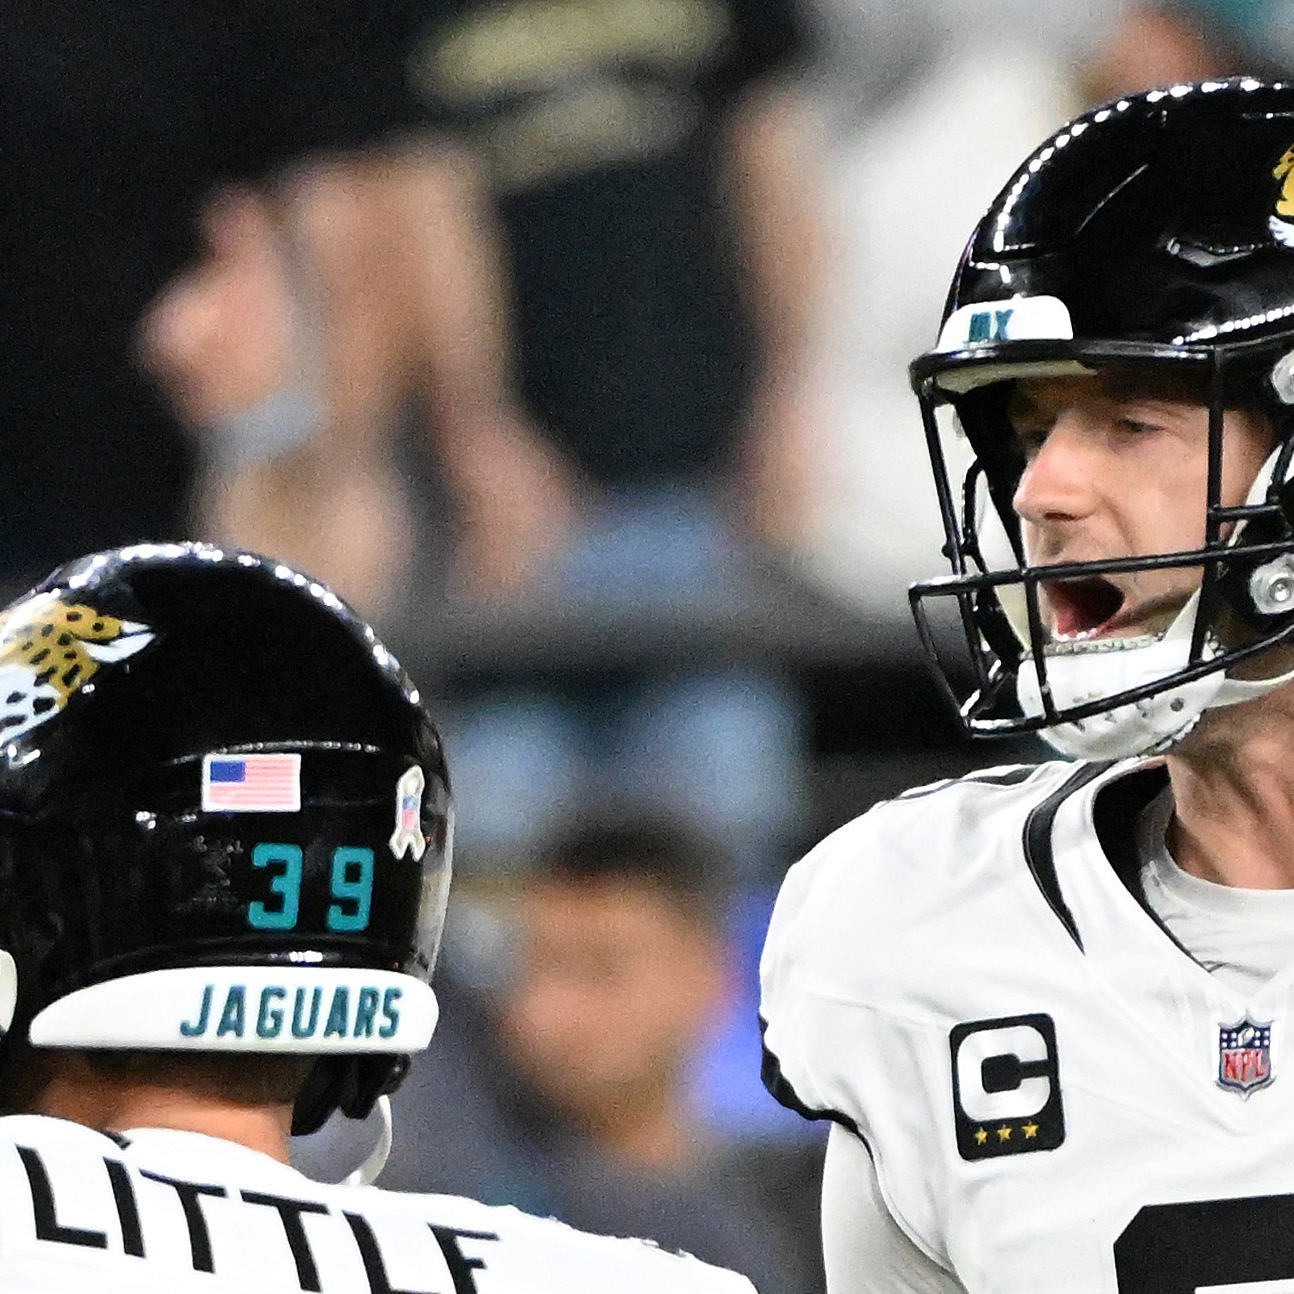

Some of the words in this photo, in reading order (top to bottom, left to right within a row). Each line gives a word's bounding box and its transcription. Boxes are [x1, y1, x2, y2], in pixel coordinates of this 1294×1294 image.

[248, 843, 374, 931] 39
[180, 984, 403, 1038] JAGUARS
[956, 1024, 1052, 1123] C
[1224, 1050, 1266, 1082] NFL
